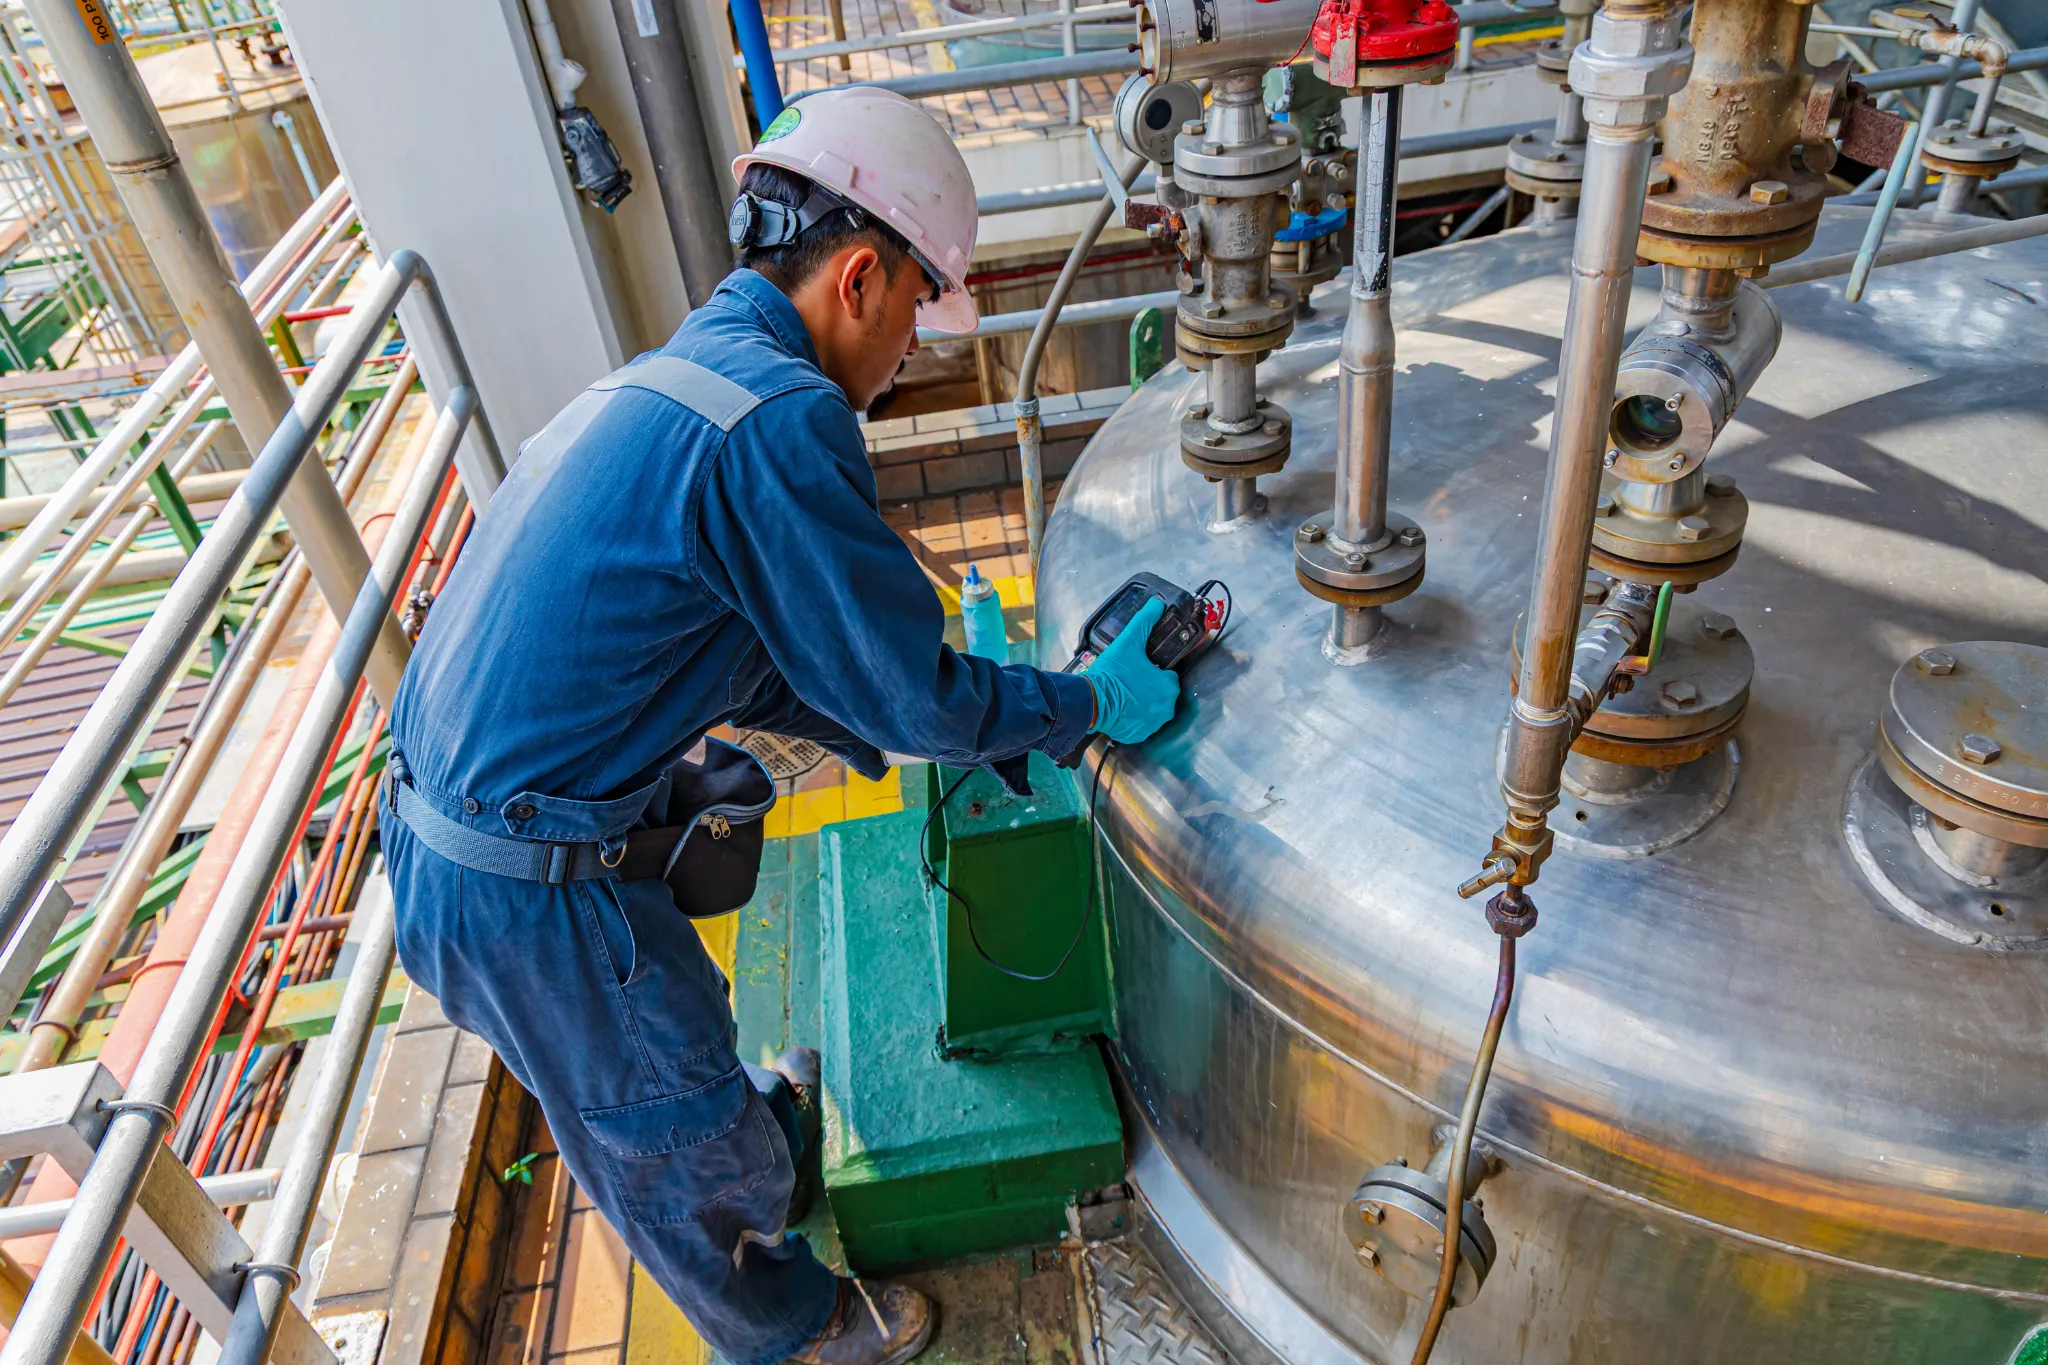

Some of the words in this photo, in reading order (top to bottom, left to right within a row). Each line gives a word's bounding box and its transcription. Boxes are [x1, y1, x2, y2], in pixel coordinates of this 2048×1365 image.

[82, 0, 96, 13] P
[92, 16, 109, 41] 100
[1992, 789, 2020, 805] 150
